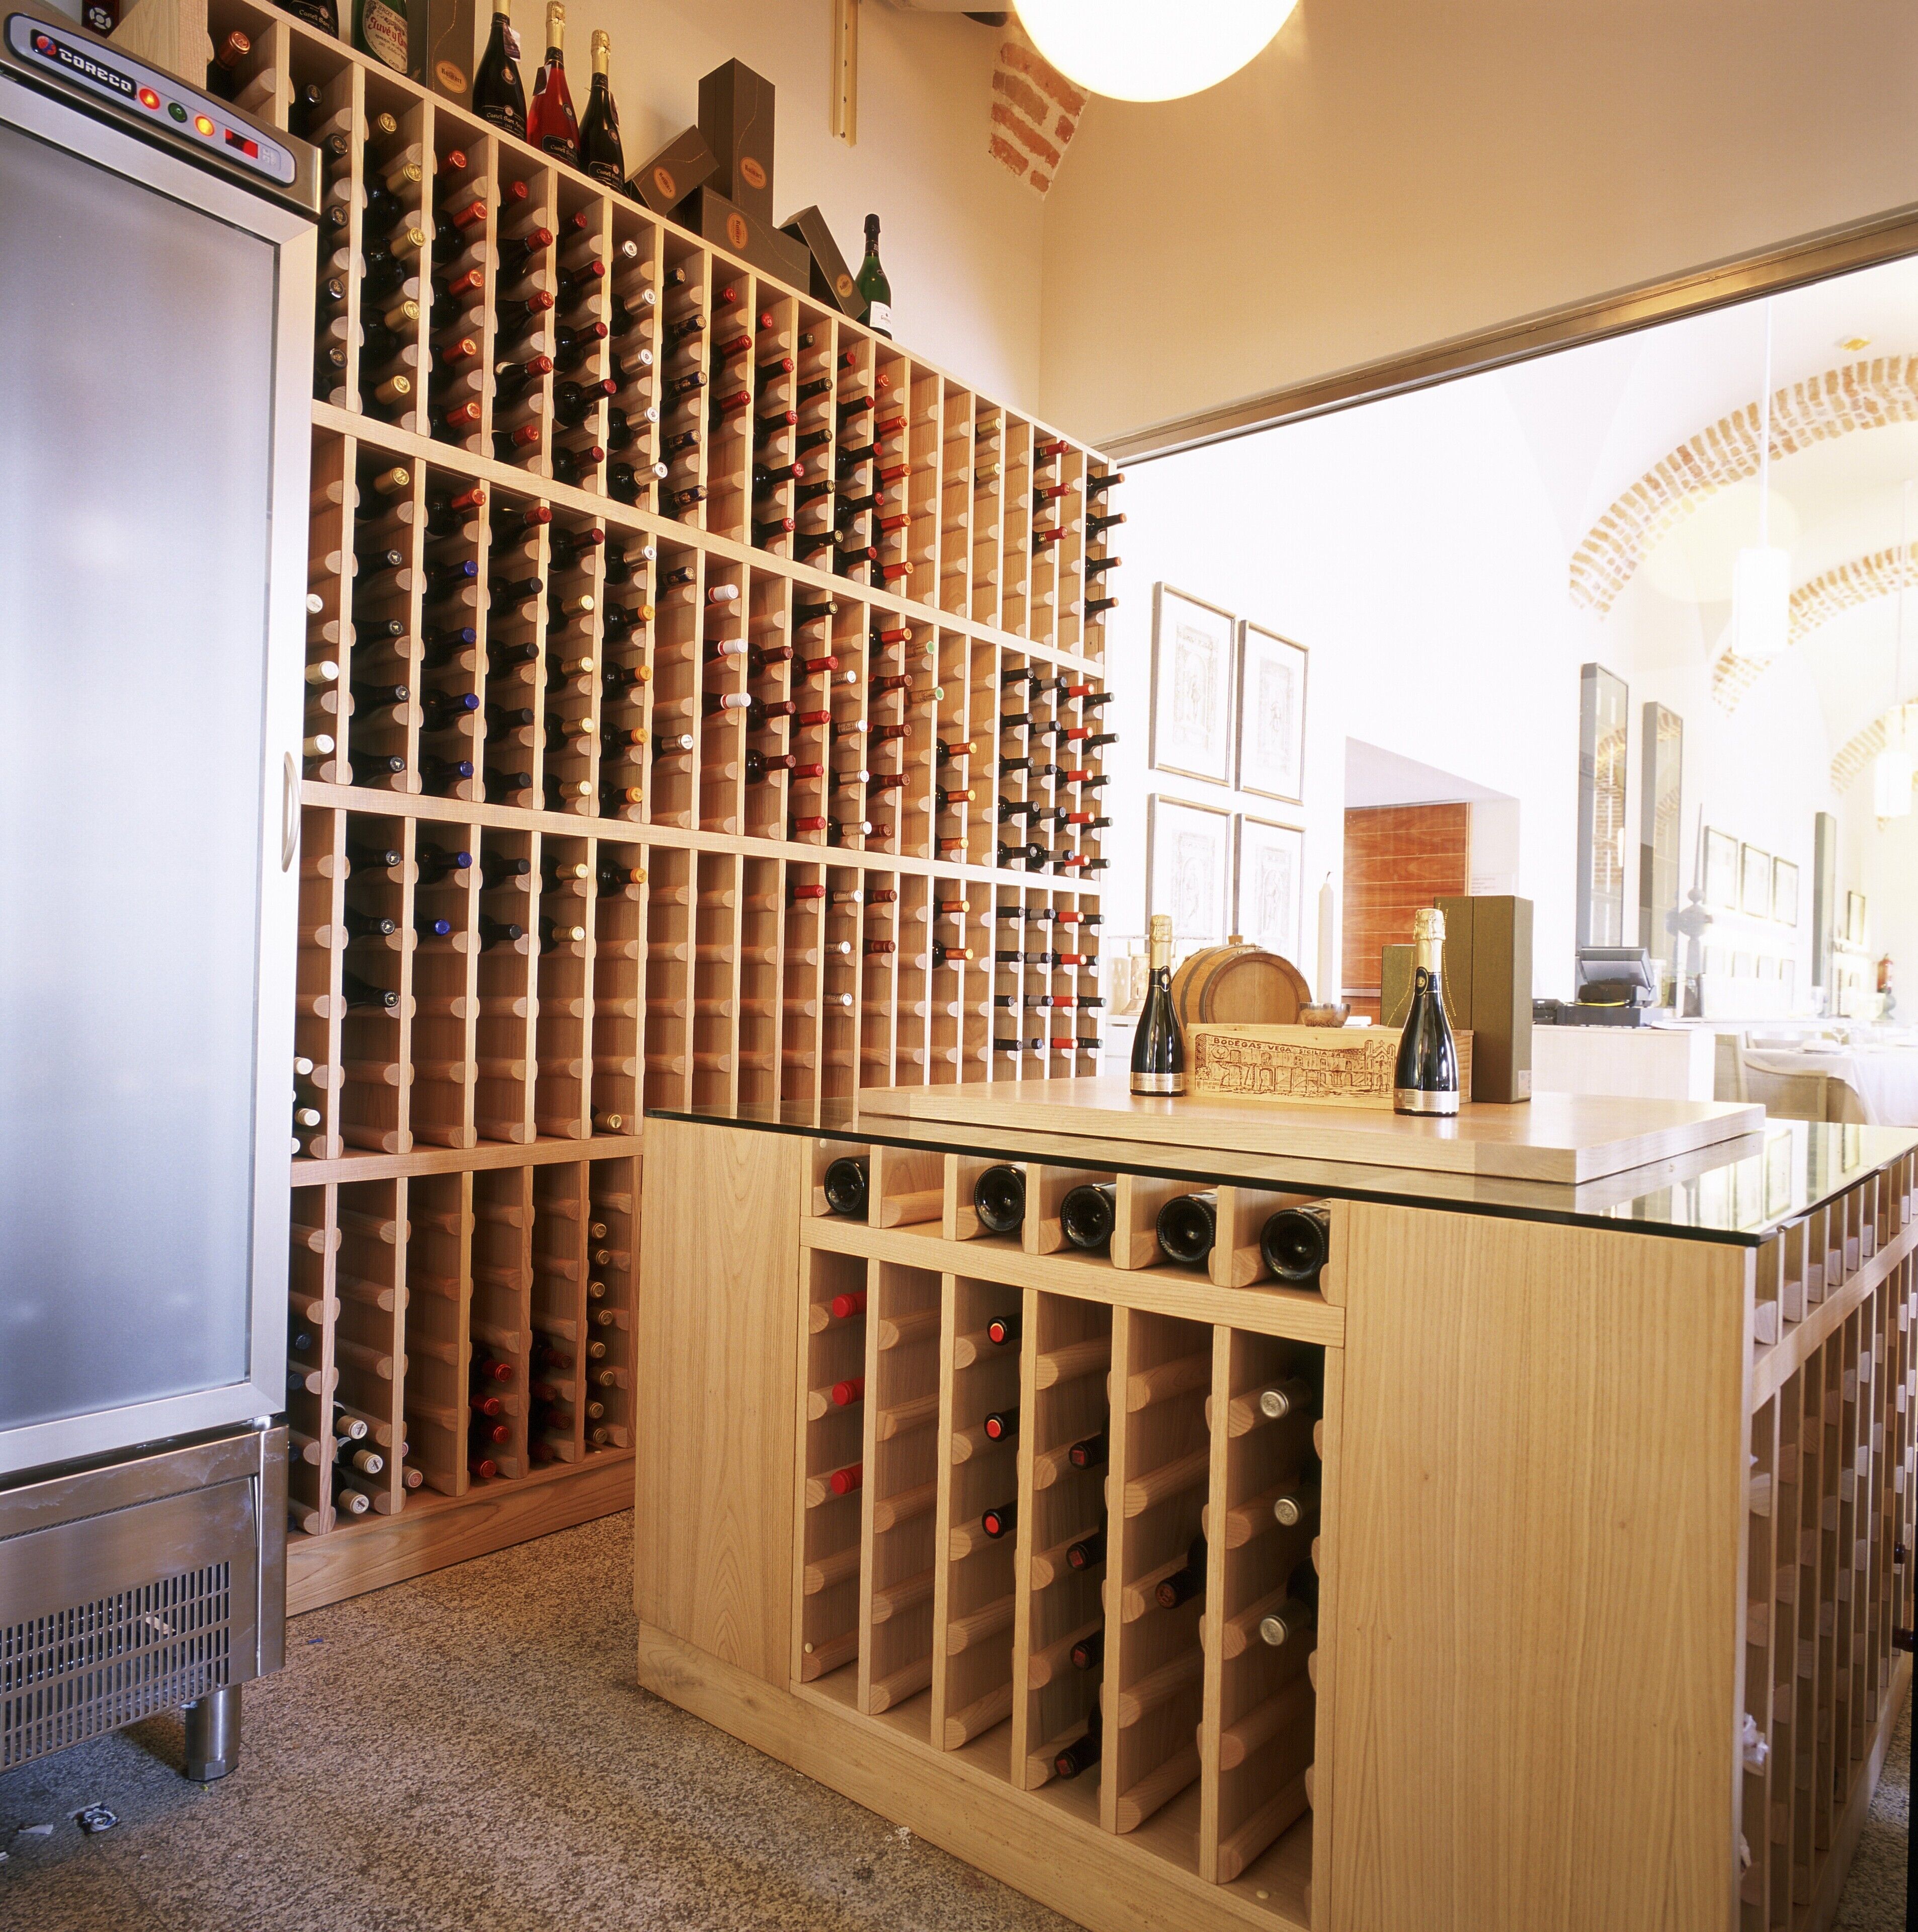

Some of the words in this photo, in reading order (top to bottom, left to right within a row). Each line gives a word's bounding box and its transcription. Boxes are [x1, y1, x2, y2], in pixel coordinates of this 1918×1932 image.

[299, 9, 318, 21] Castell
[368, 16, 391, 36] Juvé
[389, 32, 396, 42] y
[58, 48, 132, 93] CORECO
[441, 67, 462, 85] Ruinart
[504, 116, 515, 125] Sant
[550, 144, 566, 153] Castell
[596, 169, 612, 177] Castell
[744, 164, 762, 180] Ruinart
[1214, 1037, 1262, 1050] BODEGAS
[1268, 1044, 1292, 1053] VEGA
